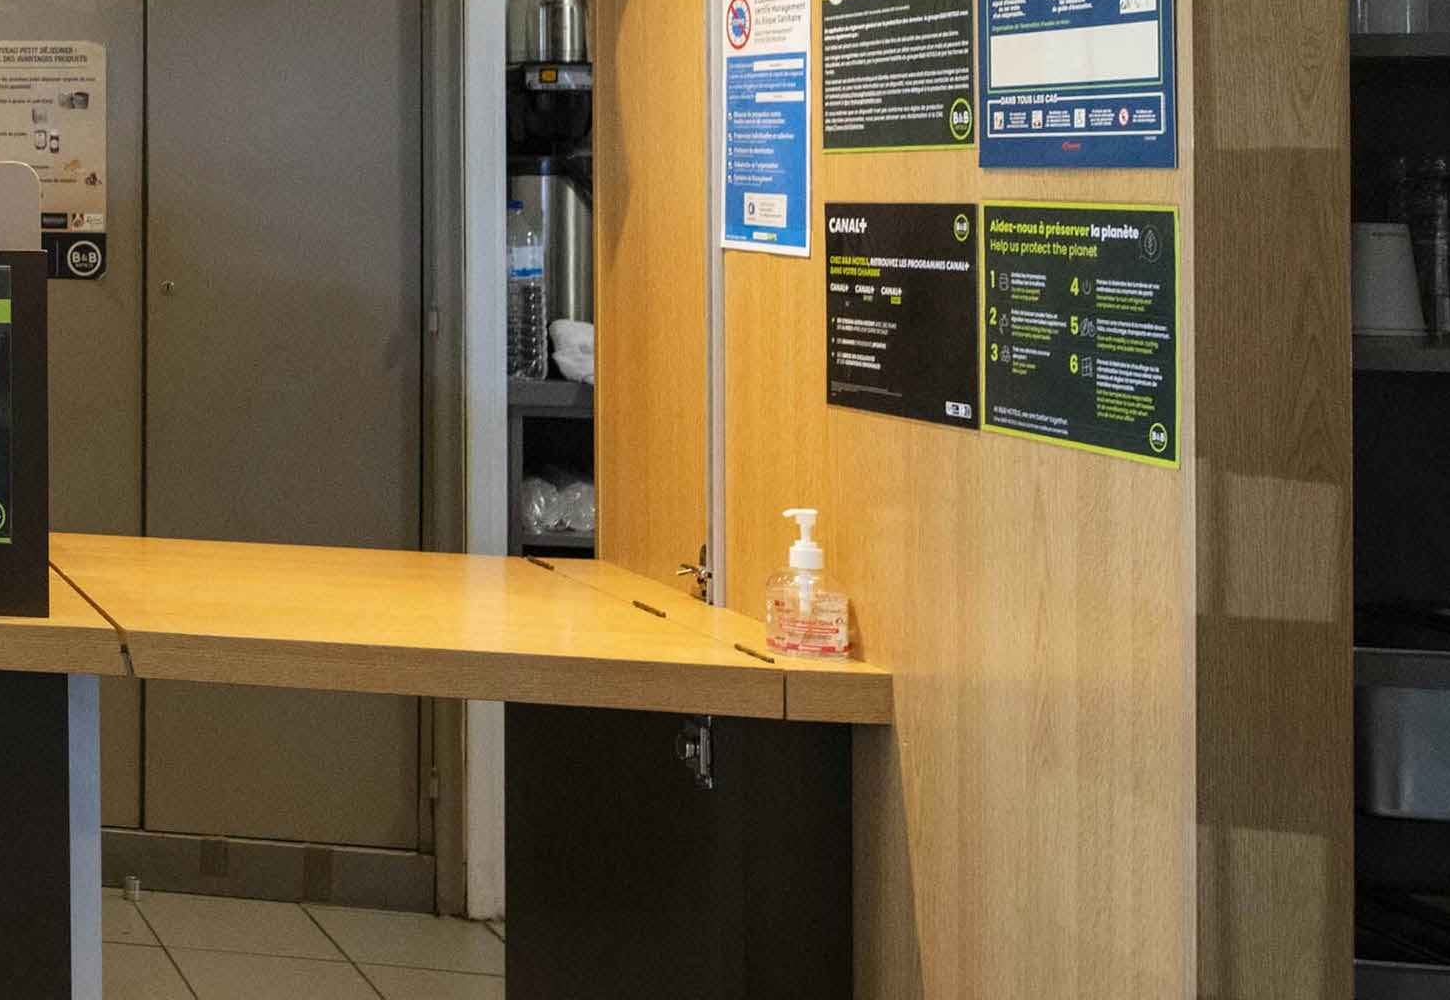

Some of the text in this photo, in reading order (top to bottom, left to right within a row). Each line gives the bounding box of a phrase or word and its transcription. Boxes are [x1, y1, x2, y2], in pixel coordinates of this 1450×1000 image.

[952, 111, 969, 125] B&B
[829, 217, 868, 234] CANAL+
[990, 220, 1140, 242] Aidez-nous à préserver la planète
[72, 251, 97, 263] B&B
[990, 239, 1098, 260] Help us protect the planet
[946, 261, 970, 271] CANAL+
[990, 269, 995, 289] 1
[1069, 276, 1080, 296] 4
[881, 286, 902, 296] CANAL+
[989, 306, 997, 326] 2
[1070, 315, 1079, 335] 5
[990, 343, 998, 362] 3
[1069, 353, 1079, 374] 6
